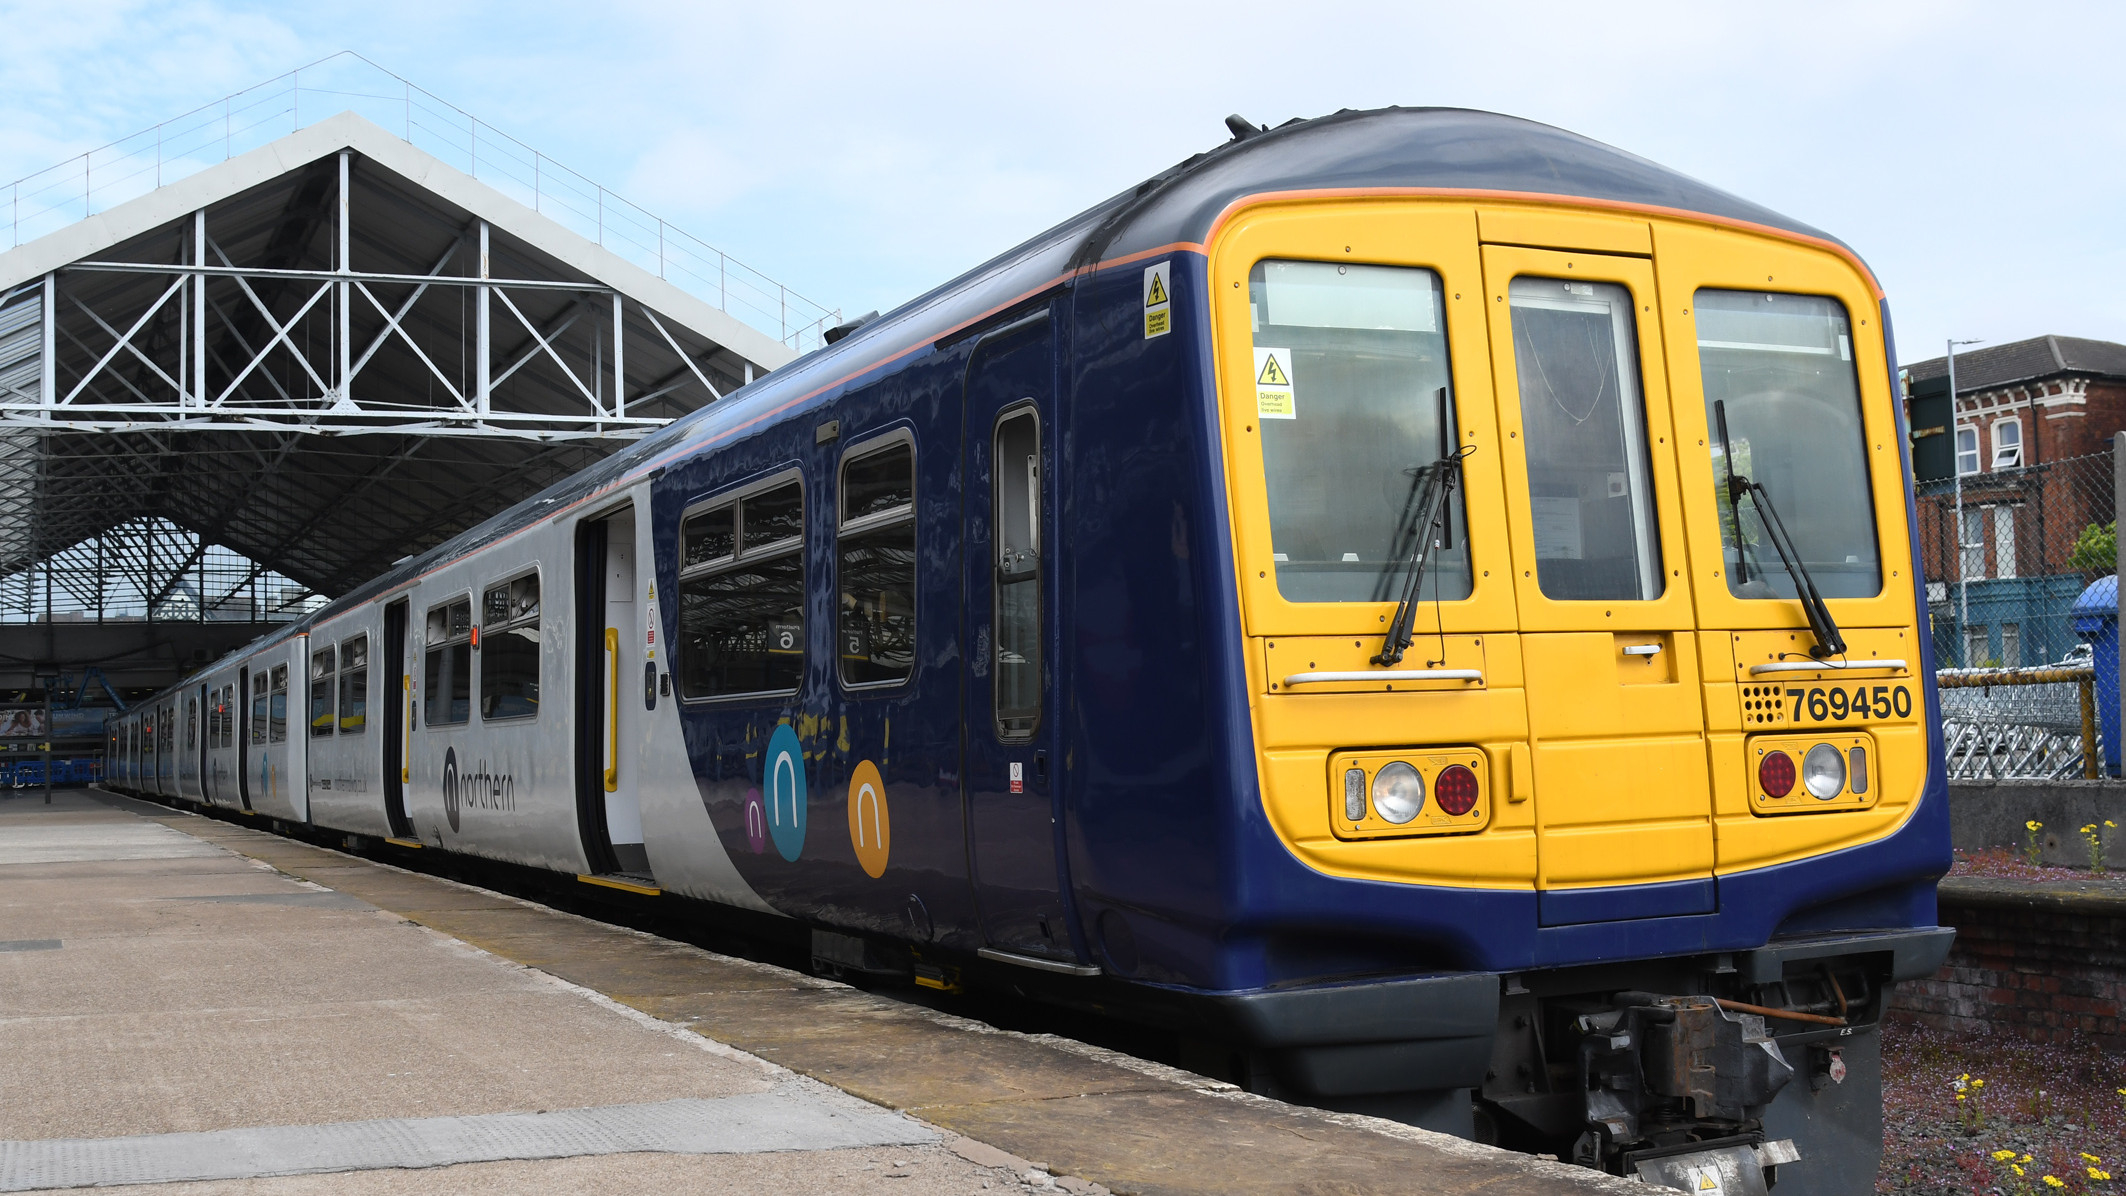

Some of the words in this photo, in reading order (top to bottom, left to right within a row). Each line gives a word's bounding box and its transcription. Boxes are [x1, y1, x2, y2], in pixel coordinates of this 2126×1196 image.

[1149, 312, 1166, 322] Danger
[1260, 392, 1285, 401] Danger
[1785, 685, 1912, 722] 769450
[460, 758, 516, 812] northern
